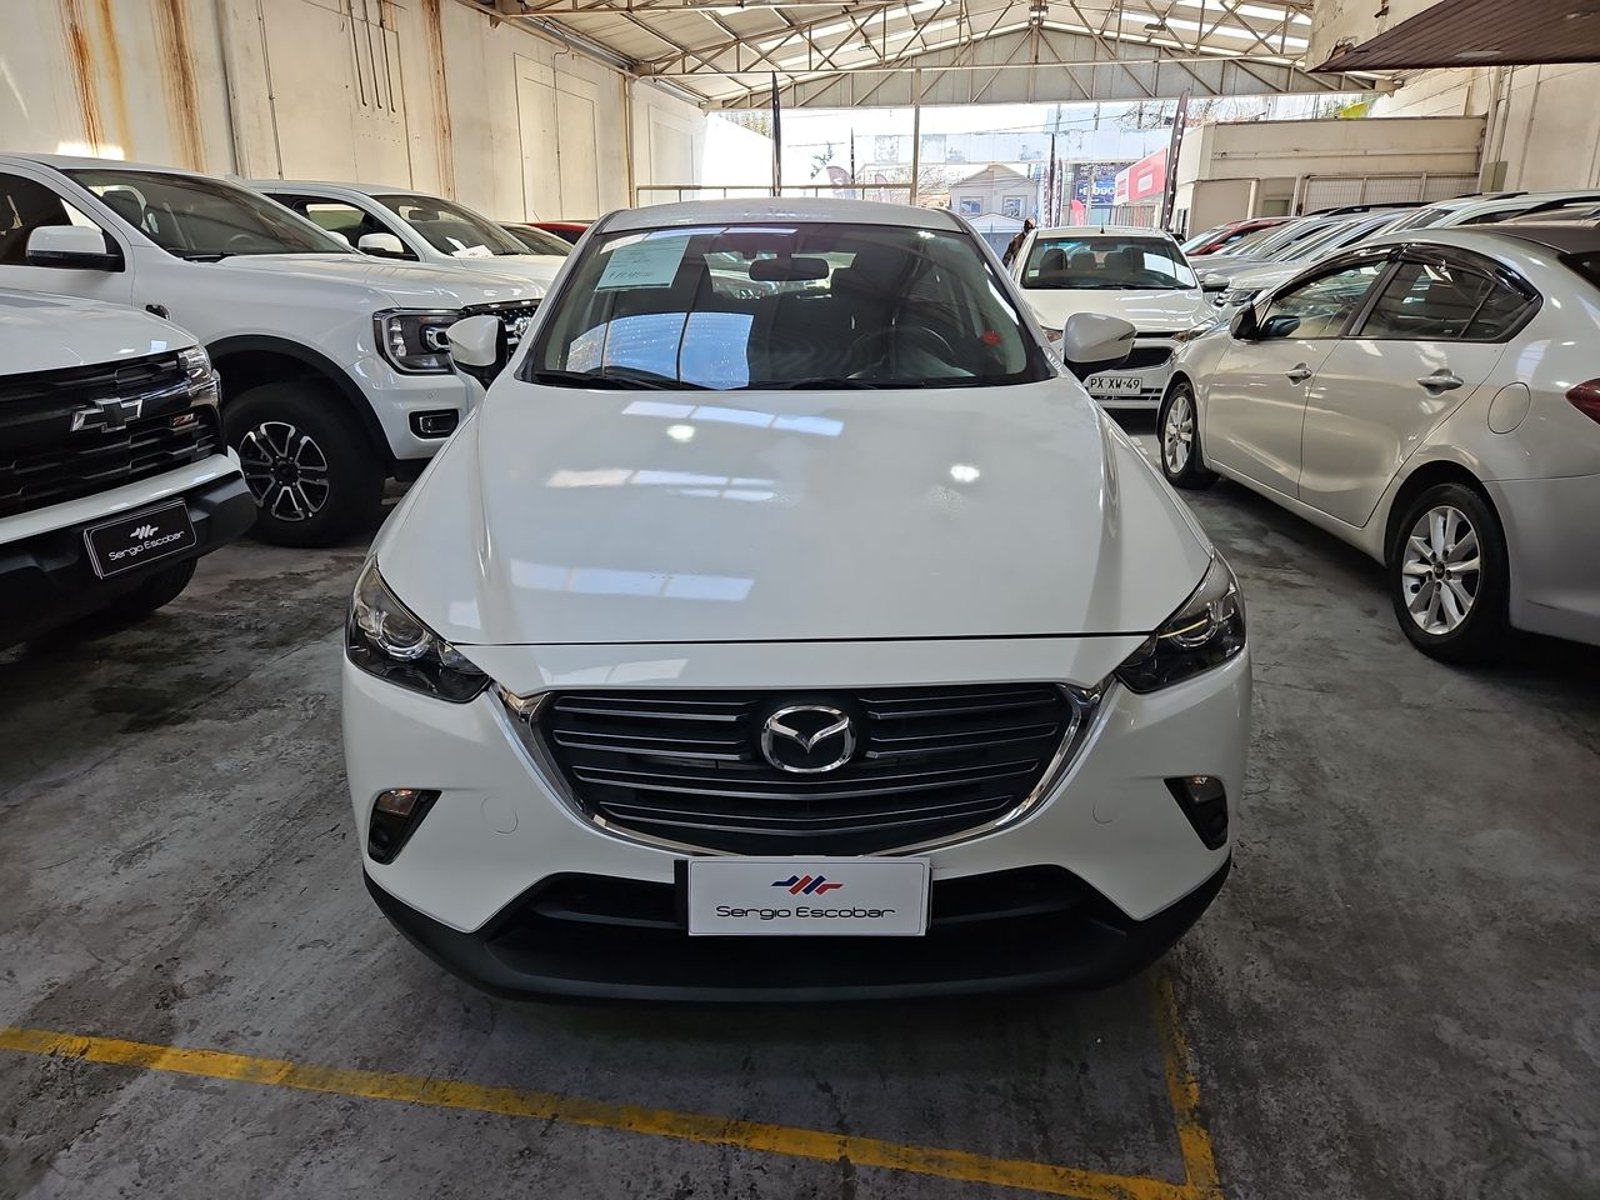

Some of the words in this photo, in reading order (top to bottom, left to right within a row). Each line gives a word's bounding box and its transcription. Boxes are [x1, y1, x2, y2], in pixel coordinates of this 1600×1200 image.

[1091, 377, 1104, 388] PX
[1108, 378, 1122, 389] XW
[1126, 377, 1140, 389] 49
[108, 545, 144, 561] Sergio
[144, 531, 185, 549] Escobar
[716, 905, 791, 921] Sergio
[796, 905, 896, 919] Escobar
